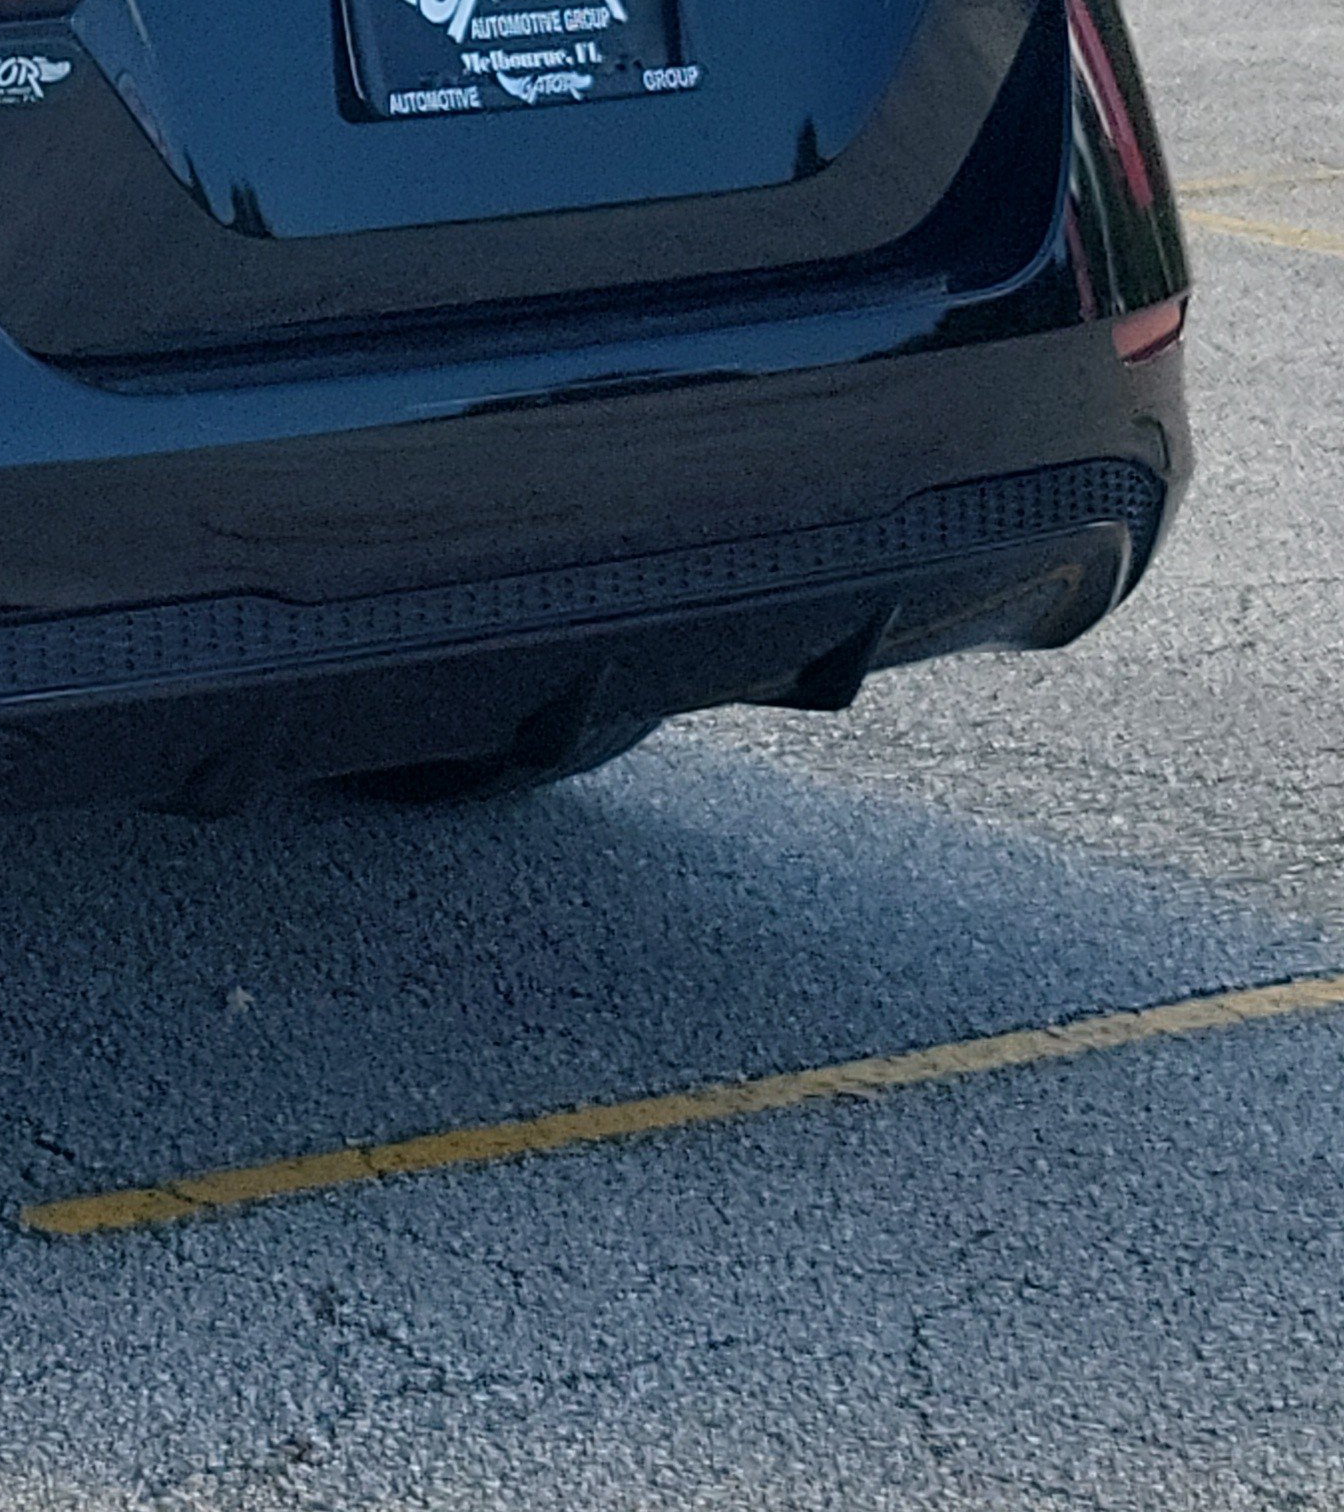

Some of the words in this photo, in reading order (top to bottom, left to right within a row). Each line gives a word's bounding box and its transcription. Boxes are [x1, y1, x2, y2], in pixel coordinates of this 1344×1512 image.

[471, 8, 564, 40] AUTOMOTIVE
[564, 5, 611, 33] GROUP
[643, 65, 699, 90] GROUP
[389, 84, 481, 115] AUTOMOTIVE
